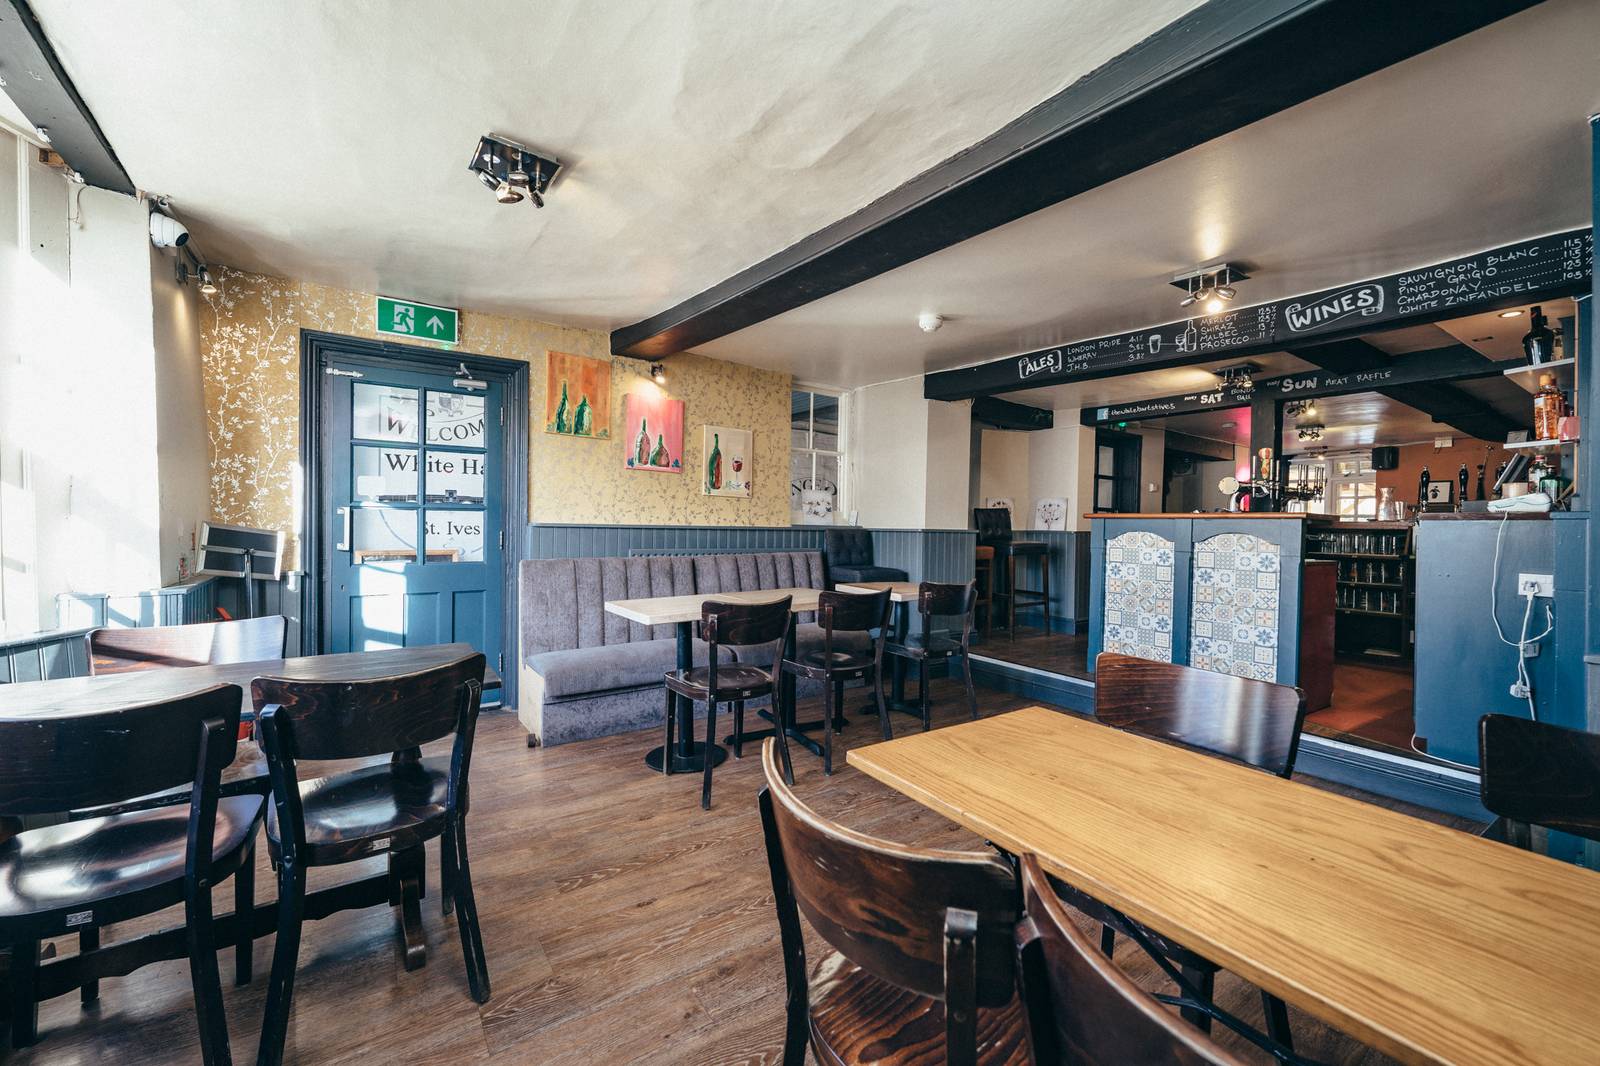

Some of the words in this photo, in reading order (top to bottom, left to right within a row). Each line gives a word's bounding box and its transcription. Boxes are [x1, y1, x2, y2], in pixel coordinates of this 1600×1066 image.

[1398, 261, 1477, 286] SAUVIGNON
[1487, 246, 1540, 266] BLANC
[1563, 238, 1582, 249] 11.5
[1398, 281, 1436, 295] PINOT
[1447, 267, 1497, 284] GRIGIO
[1563, 249, 1581, 259] 11.5
[1397, 280, 1482, 305] CHARDONAY
[1563, 259, 1581, 270] 12.5
[1399, 299, 1438, 314] WHITE
[1445, 281, 1540, 306] ZINFANDEL
[1562, 270, 1582, 281] 10.5
[1290, 287, 1375, 330] WINES
[1200, 312, 1239, 326] MERLOT
[1200, 321, 1236, 335] SHIRAZ
[1200, 329, 1239, 342] MALBEC
[1200, 335, 1249, 350] PROSECCO
[1067, 344, 1096, 355] LONDON
[1099, 338, 1121, 349] PRIDE
[1025, 354, 1054, 376] ALES
[1281, 376, 1318, 393] SUN
[1325, 376, 1349, 387] MEAT
[1356, 370, 1392, 383] RAFFLE
[1200, 392, 1225, 405] SAT
[447, 521, 481, 536] Ives
